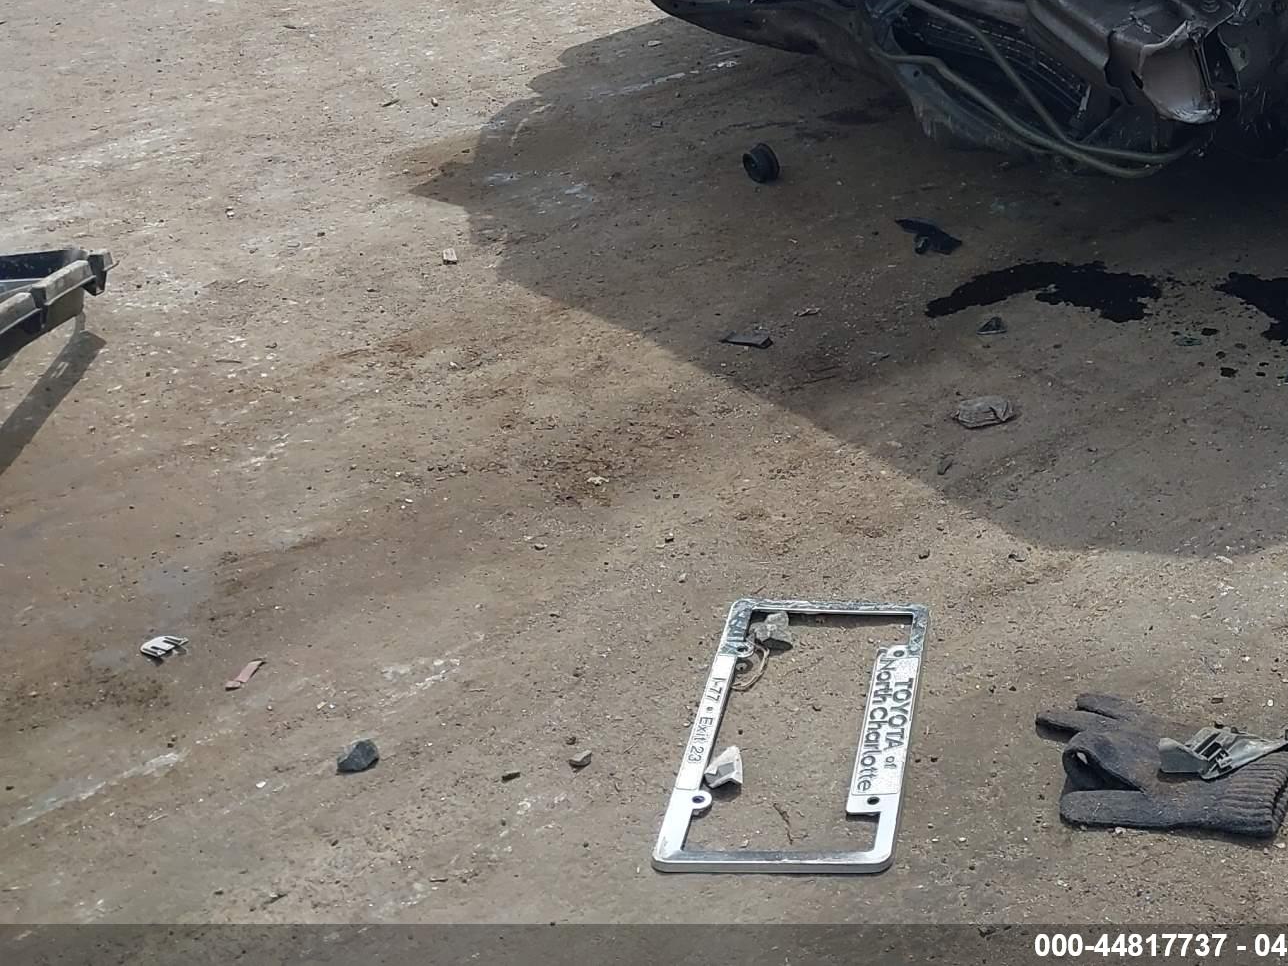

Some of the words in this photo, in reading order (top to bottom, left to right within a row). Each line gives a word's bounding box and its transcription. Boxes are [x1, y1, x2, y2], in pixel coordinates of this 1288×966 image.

[872, 659, 897, 704] North
[693, 716, 714, 743] Exit
[883, 677, 914, 751] TOYOTA
[688, 745, 705, 763] 23
[857, 706, 890, 792] Charlotte
[884, 756, 897, 769] of
